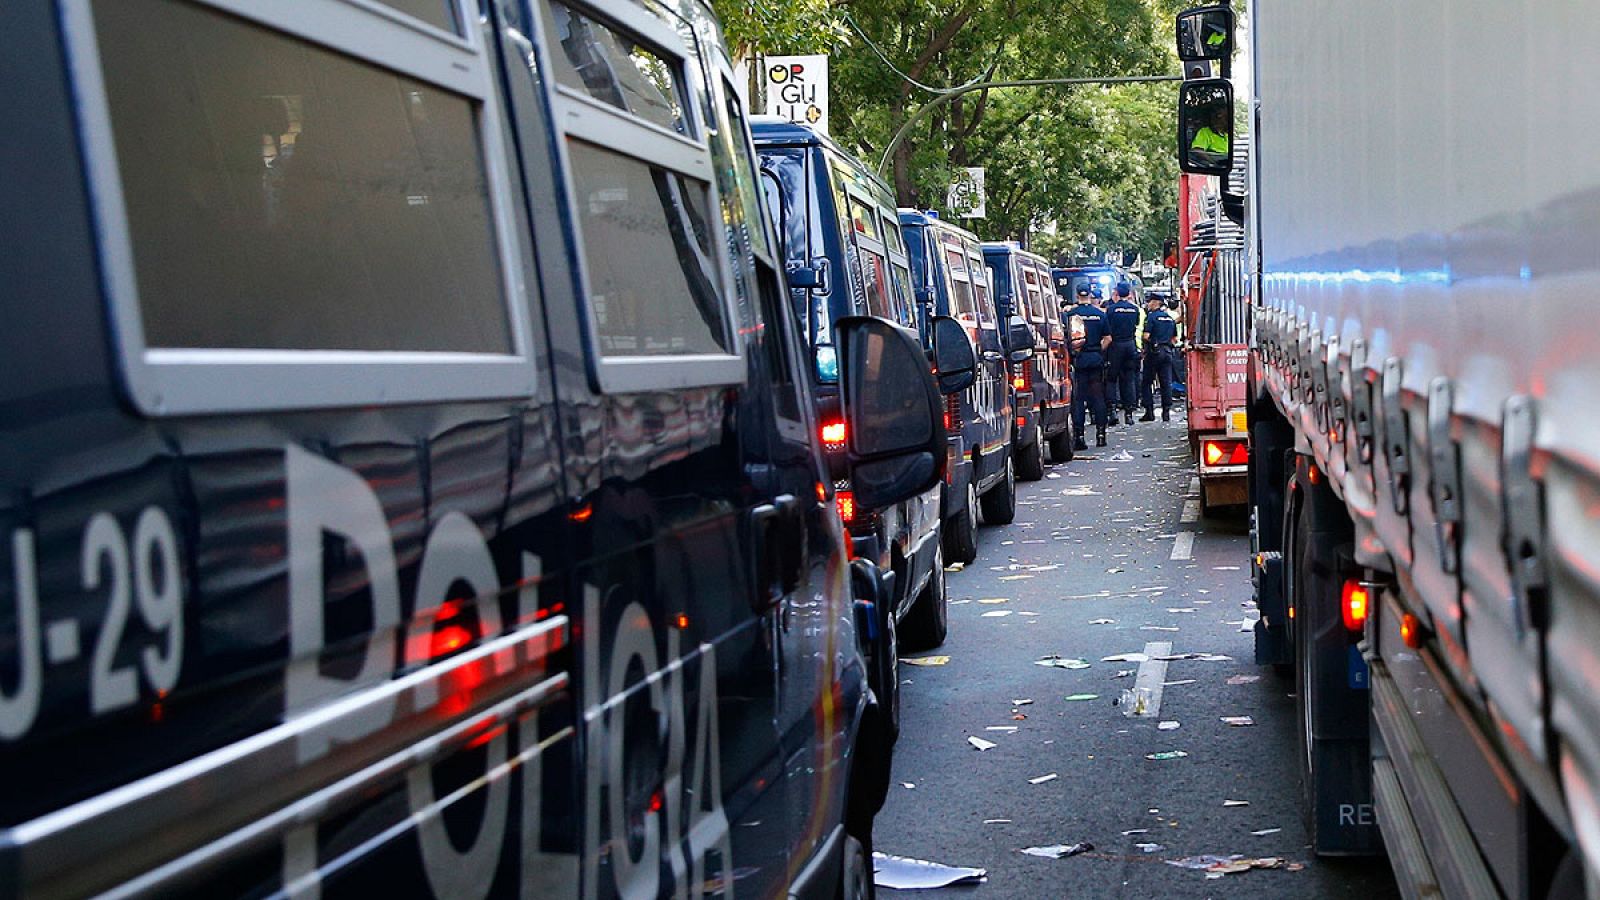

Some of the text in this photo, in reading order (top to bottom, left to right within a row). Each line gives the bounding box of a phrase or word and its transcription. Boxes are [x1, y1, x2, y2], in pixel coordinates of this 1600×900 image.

[769, 64, 805, 84] OR
[781, 84, 816, 104] GU
[1339, 804, 1379, 826] RE
